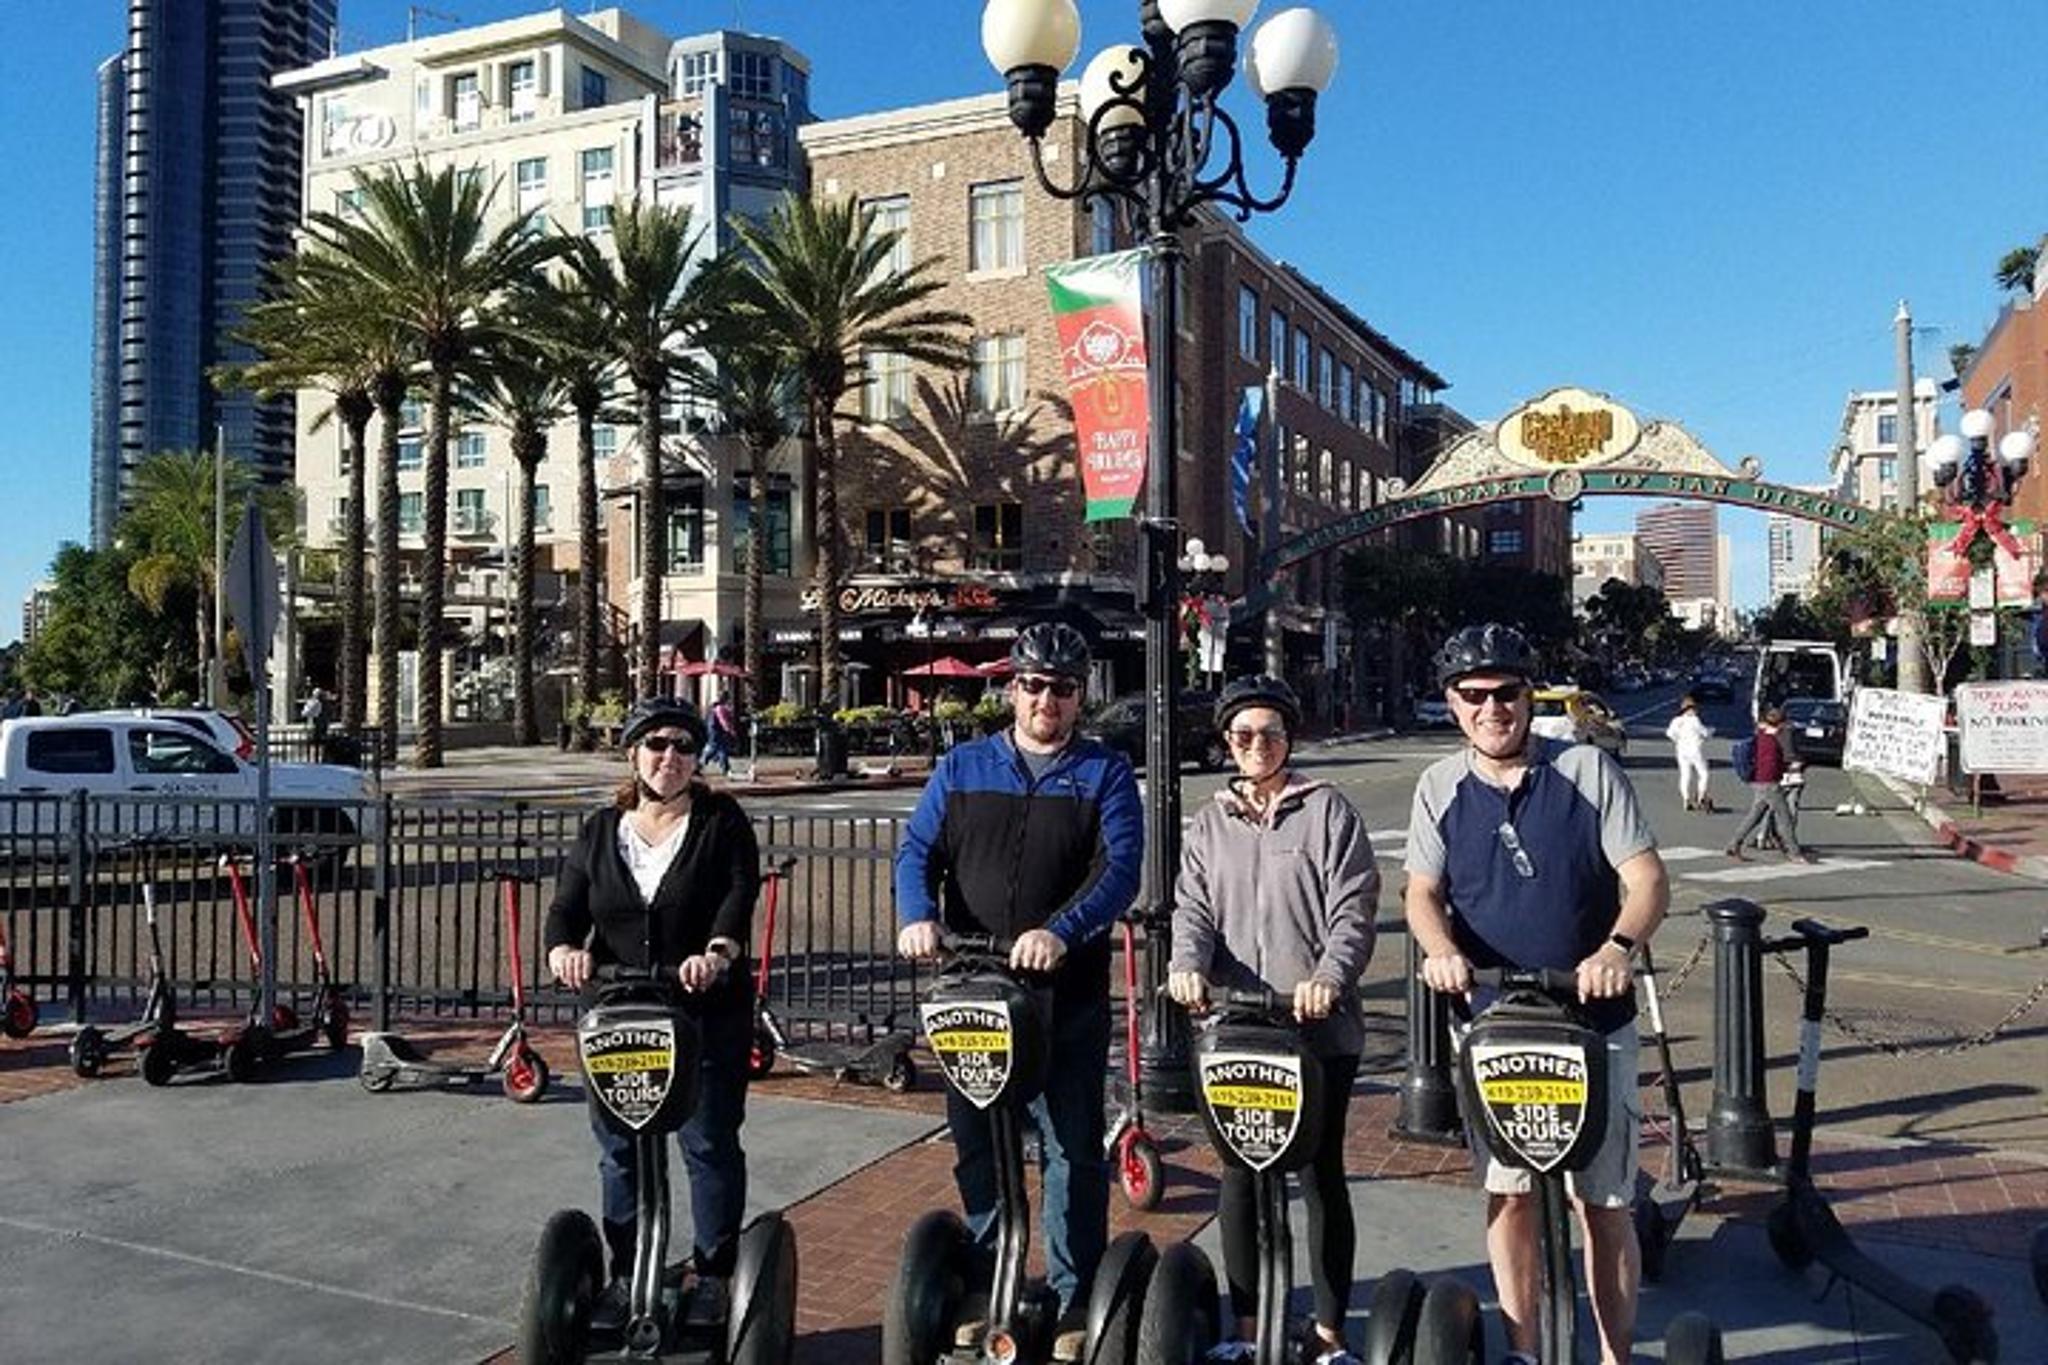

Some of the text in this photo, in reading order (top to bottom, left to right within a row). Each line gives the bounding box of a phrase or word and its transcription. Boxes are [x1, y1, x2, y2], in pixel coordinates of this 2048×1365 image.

[1612, 473, 1648, 489] OF
[1669, 475, 1730, 495] SAN
[1753, 485, 1858, 524] DIEGO
[1970, 715, 2048, 728] NO PARKIN
[928, 1011, 1008, 1031] ANOTHER
[586, 1031, 672, 1053] ANOTHER
[1205, 1063, 1298, 1090] ANOTHER
[1478, 1054, 1583, 1081] ANOTHER
[613, 1071, 651, 1087] SIDE
[604, 1086, 662, 1103] TOURS
[1234, 1108, 1275, 1125] SIDE
[1512, 1104, 1560, 1121] SIDE
[1224, 1123, 1288, 1144] TOURS
[1502, 1120, 1575, 1141] TOURS
